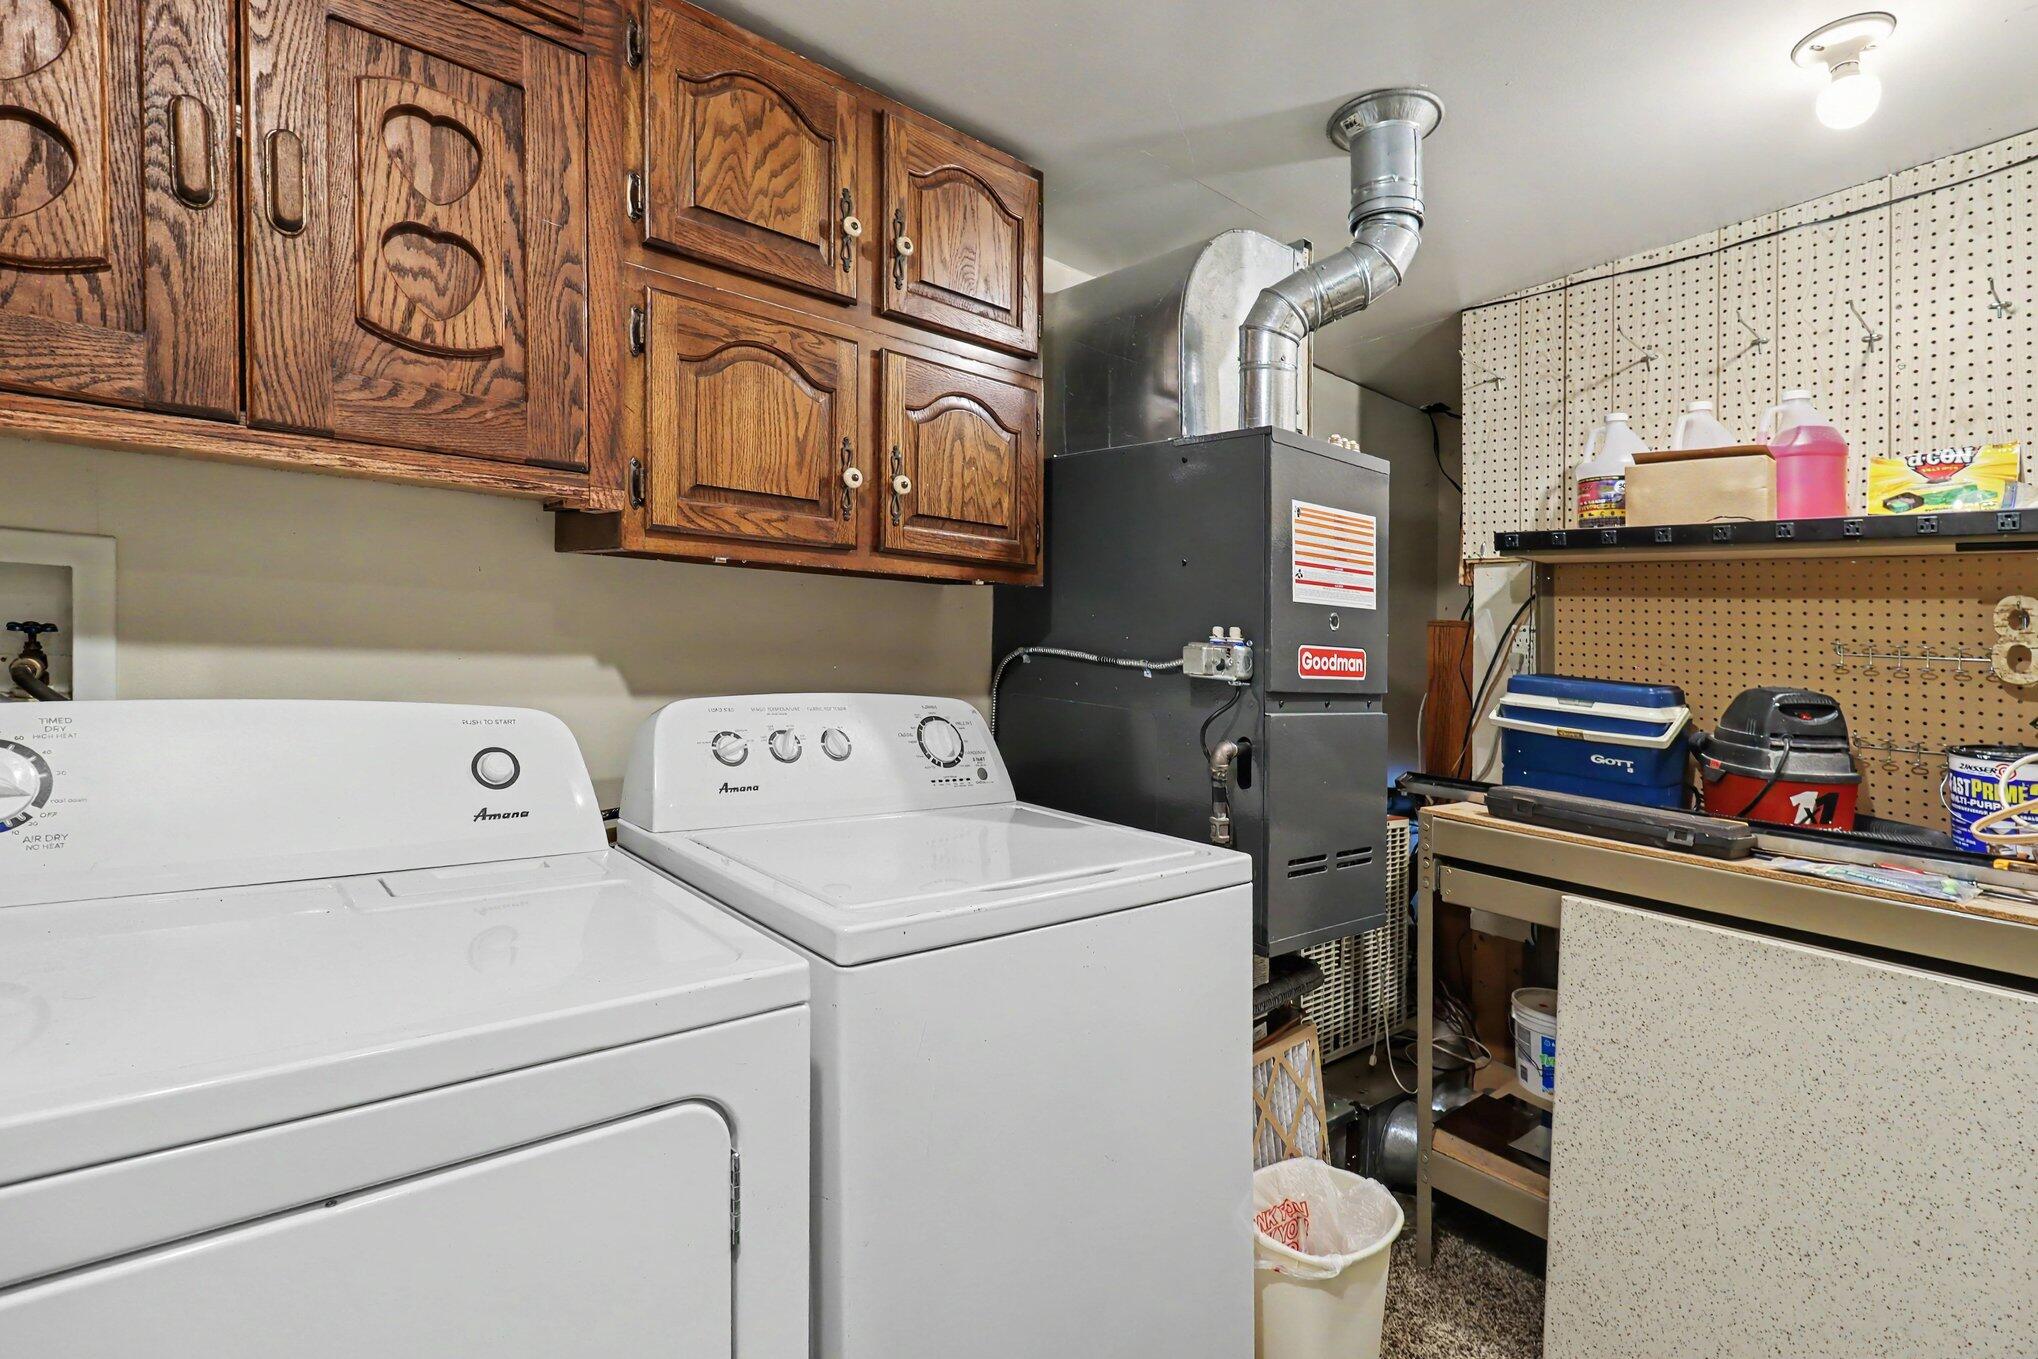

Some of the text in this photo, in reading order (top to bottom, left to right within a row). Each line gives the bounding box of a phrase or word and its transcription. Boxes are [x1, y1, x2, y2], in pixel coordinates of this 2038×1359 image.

[1301, 651, 1364, 672] Goodman
[38, 717, 73, 725] TIMED
[44, 725, 67, 733] DRY
[1590, 754, 1634, 767] GOTT
[1959, 762, 1998, 775] ZINSSER
[719, 782, 760, 794] Amana
[40, 811, 58, 819] OFF
[473, 807, 530, 822] Amana
[22, 833, 70, 844] AIR DRY
[42, 842, 66, 850] HEAT
